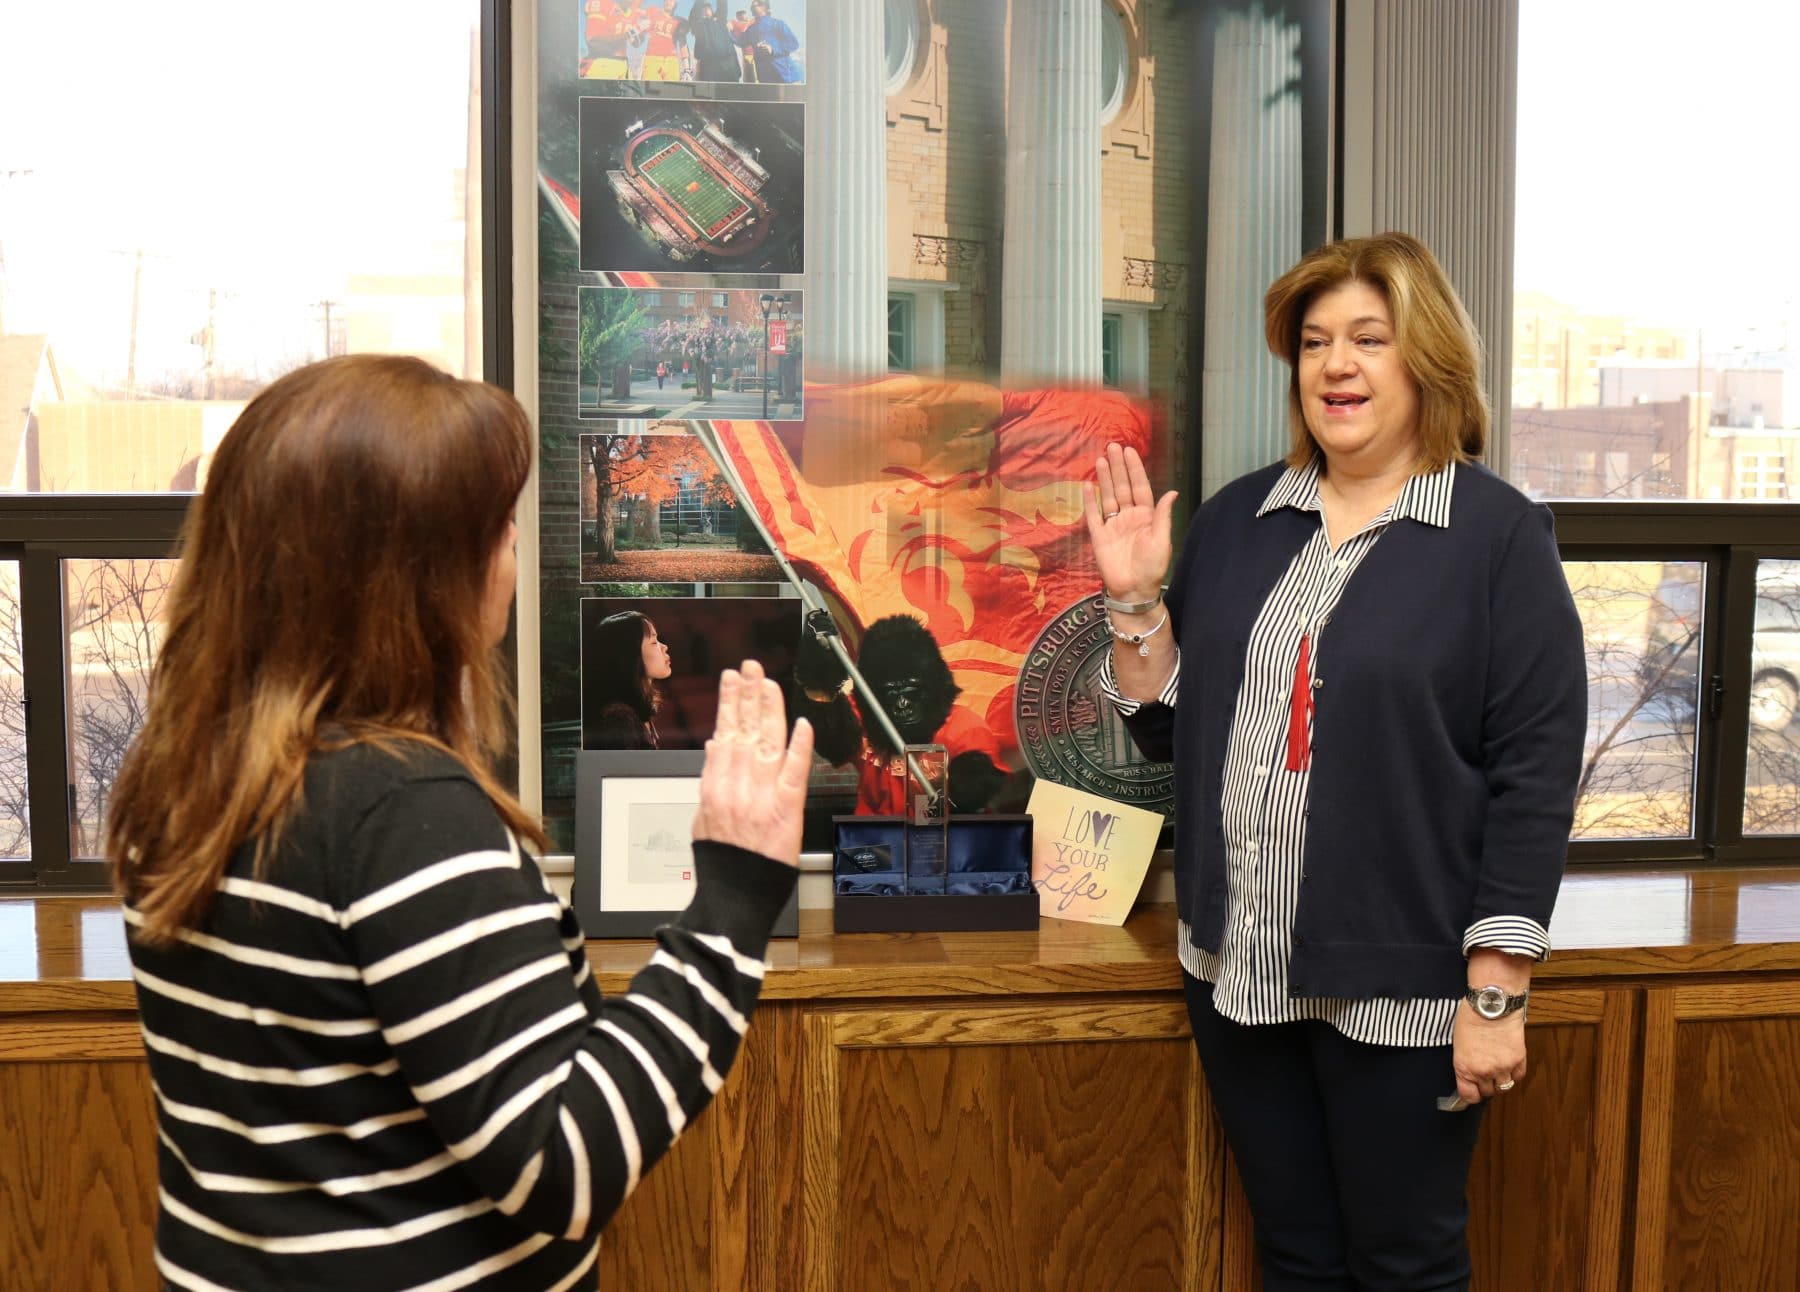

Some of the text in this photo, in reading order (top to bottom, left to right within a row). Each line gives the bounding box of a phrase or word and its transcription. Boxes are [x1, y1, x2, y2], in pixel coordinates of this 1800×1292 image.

[1021, 608, 1089, 717] PITTSBURG
[1072, 631, 1098, 657] KSTC
[1050, 667, 1069, 734] SMTN 1903
[1063, 749, 1174, 796] RESEARCH INSTRUCT
[1122, 768, 1147, 777] RUSS
[1054, 842, 1109, 872] YOUR
[1033, 863, 1108, 912] Life
